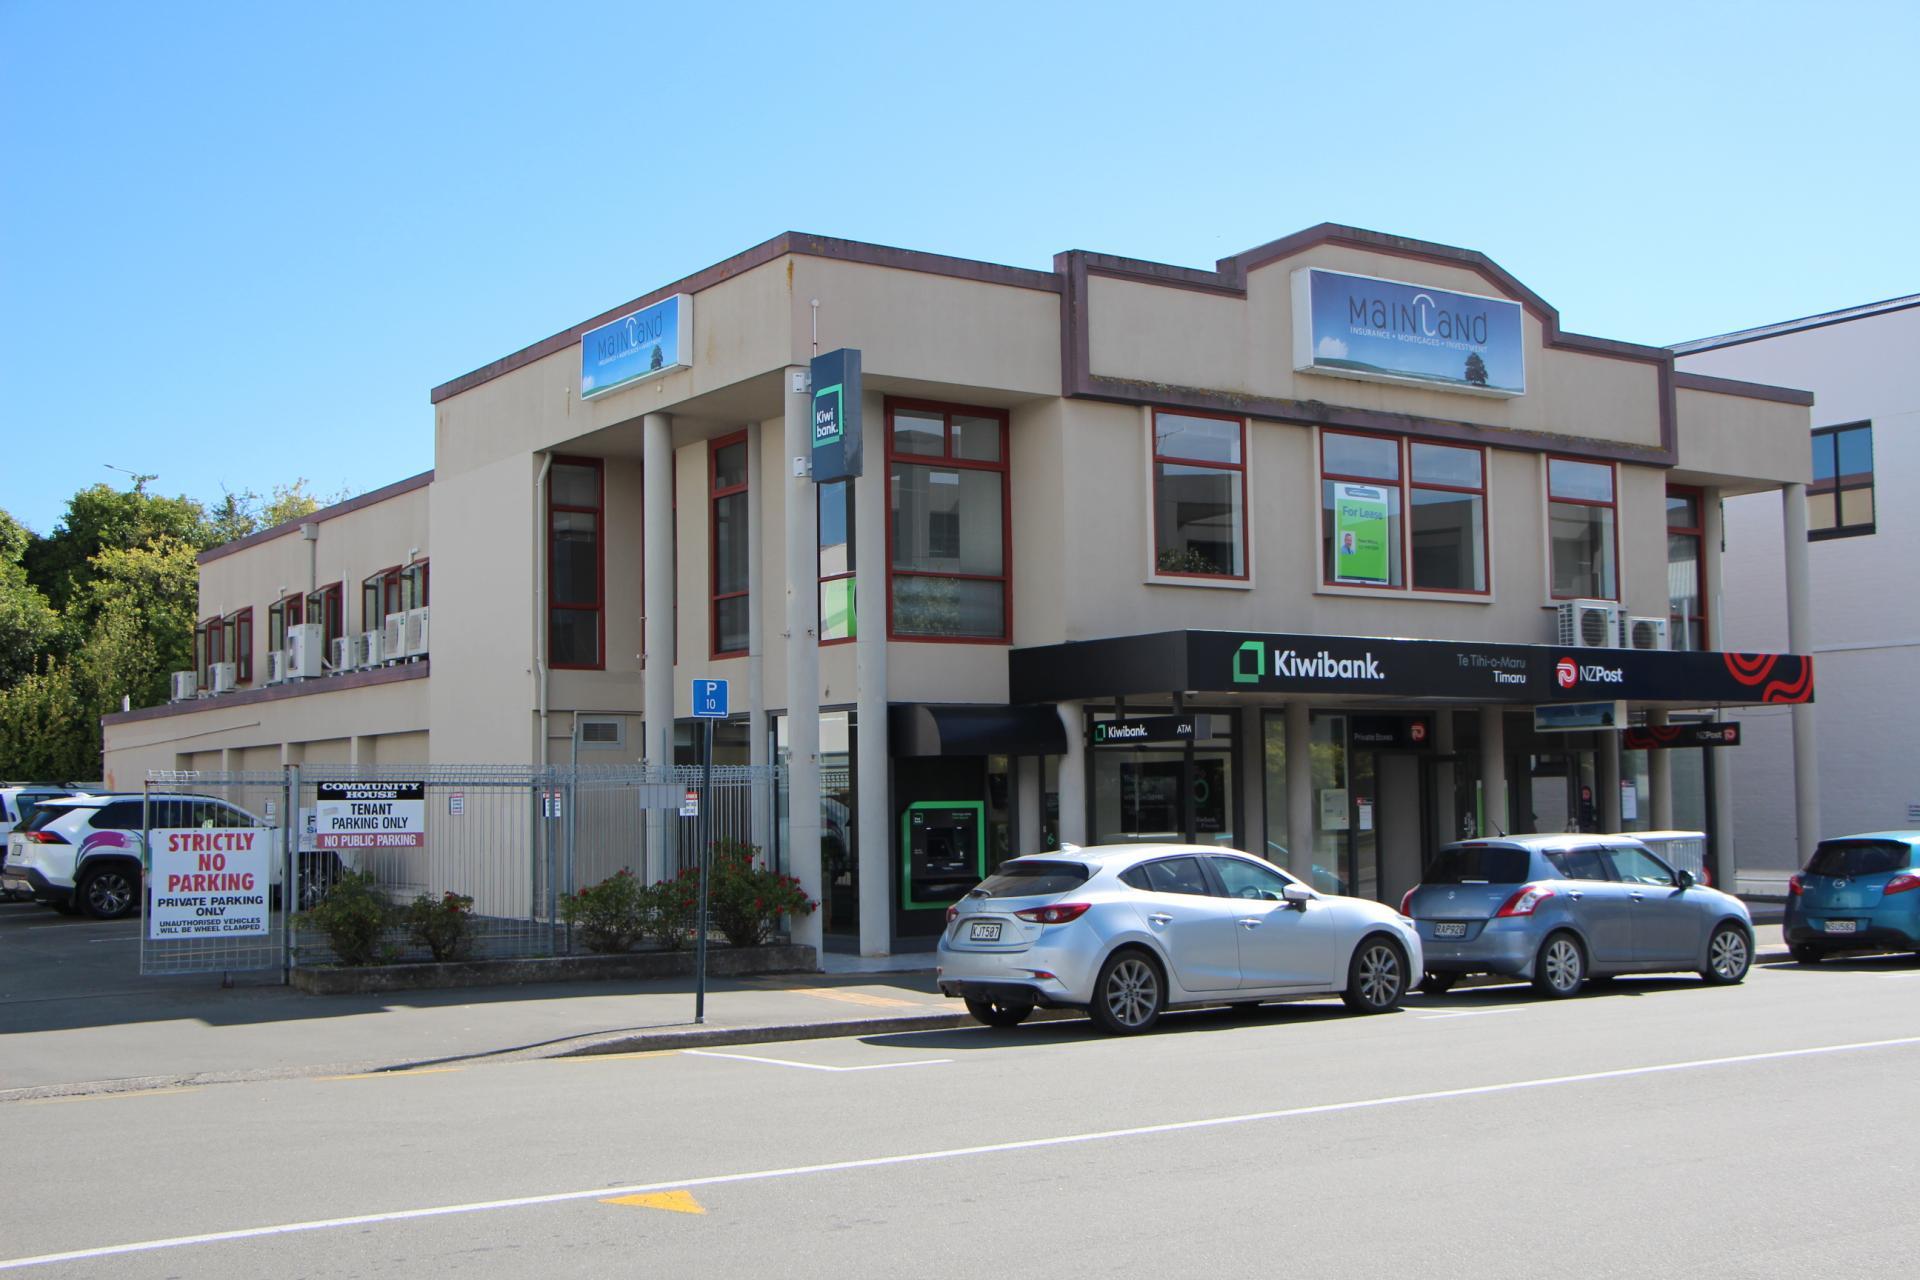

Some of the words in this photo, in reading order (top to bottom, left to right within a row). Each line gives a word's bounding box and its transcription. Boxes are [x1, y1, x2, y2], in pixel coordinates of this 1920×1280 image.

[1350, 326, 1391, 340] INSURANCE
[1398, 333, 1440, 347] MORTGAGES
[816, 407, 834, 425] Kiwi
[1342, 505, 1358, 517] For
[1359, 507, 1383, 520] Lease
[1274, 650, 1385, 679] Kiwibank.
[1457, 653, 1469, 667] Te
[1470, 654, 1527, 669] Tihi-o-Maru
[1493, 670, 1527, 684] Timaru
[1579, 665, 1623, 683] NZPost
[707, 682, 717, 695] P
[707, 699, 716, 709] 10
[1176, 724, 1192, 734] ATM
[322, 782, 420, 791] COMMUNITY
[345, 791, 398, 799] HOUSE
[350, 803, 393, 815] TENANT
[332, 817, 379, 829] PARKING
[382, 816, 409, 829] ONLY
[168, 832, 255, 852] STRICTLY
[324, 835, 338, 847] NO
[341, 834, 375, 847] PUBLIC
[377, 834, 417, 846] PARKING
[198, 853, 226, 872] NO
[168, 872, 255, 893] PARKING
[158, 896, 207, 908] PRIVATE
[211, 895, 264, 906] PARKING
[196, 906, 226, 917] ONLY
[159, 918, 221, 928] UNAUTHORISED
[223, 917, 261, 925] VEHICLES
[160, 926, 179, 934] WILL
[181, 925, 192, 933] BE
[194, 925, 221, 933] WHEEL
[223, 923, 260, 931] CLAMPED
